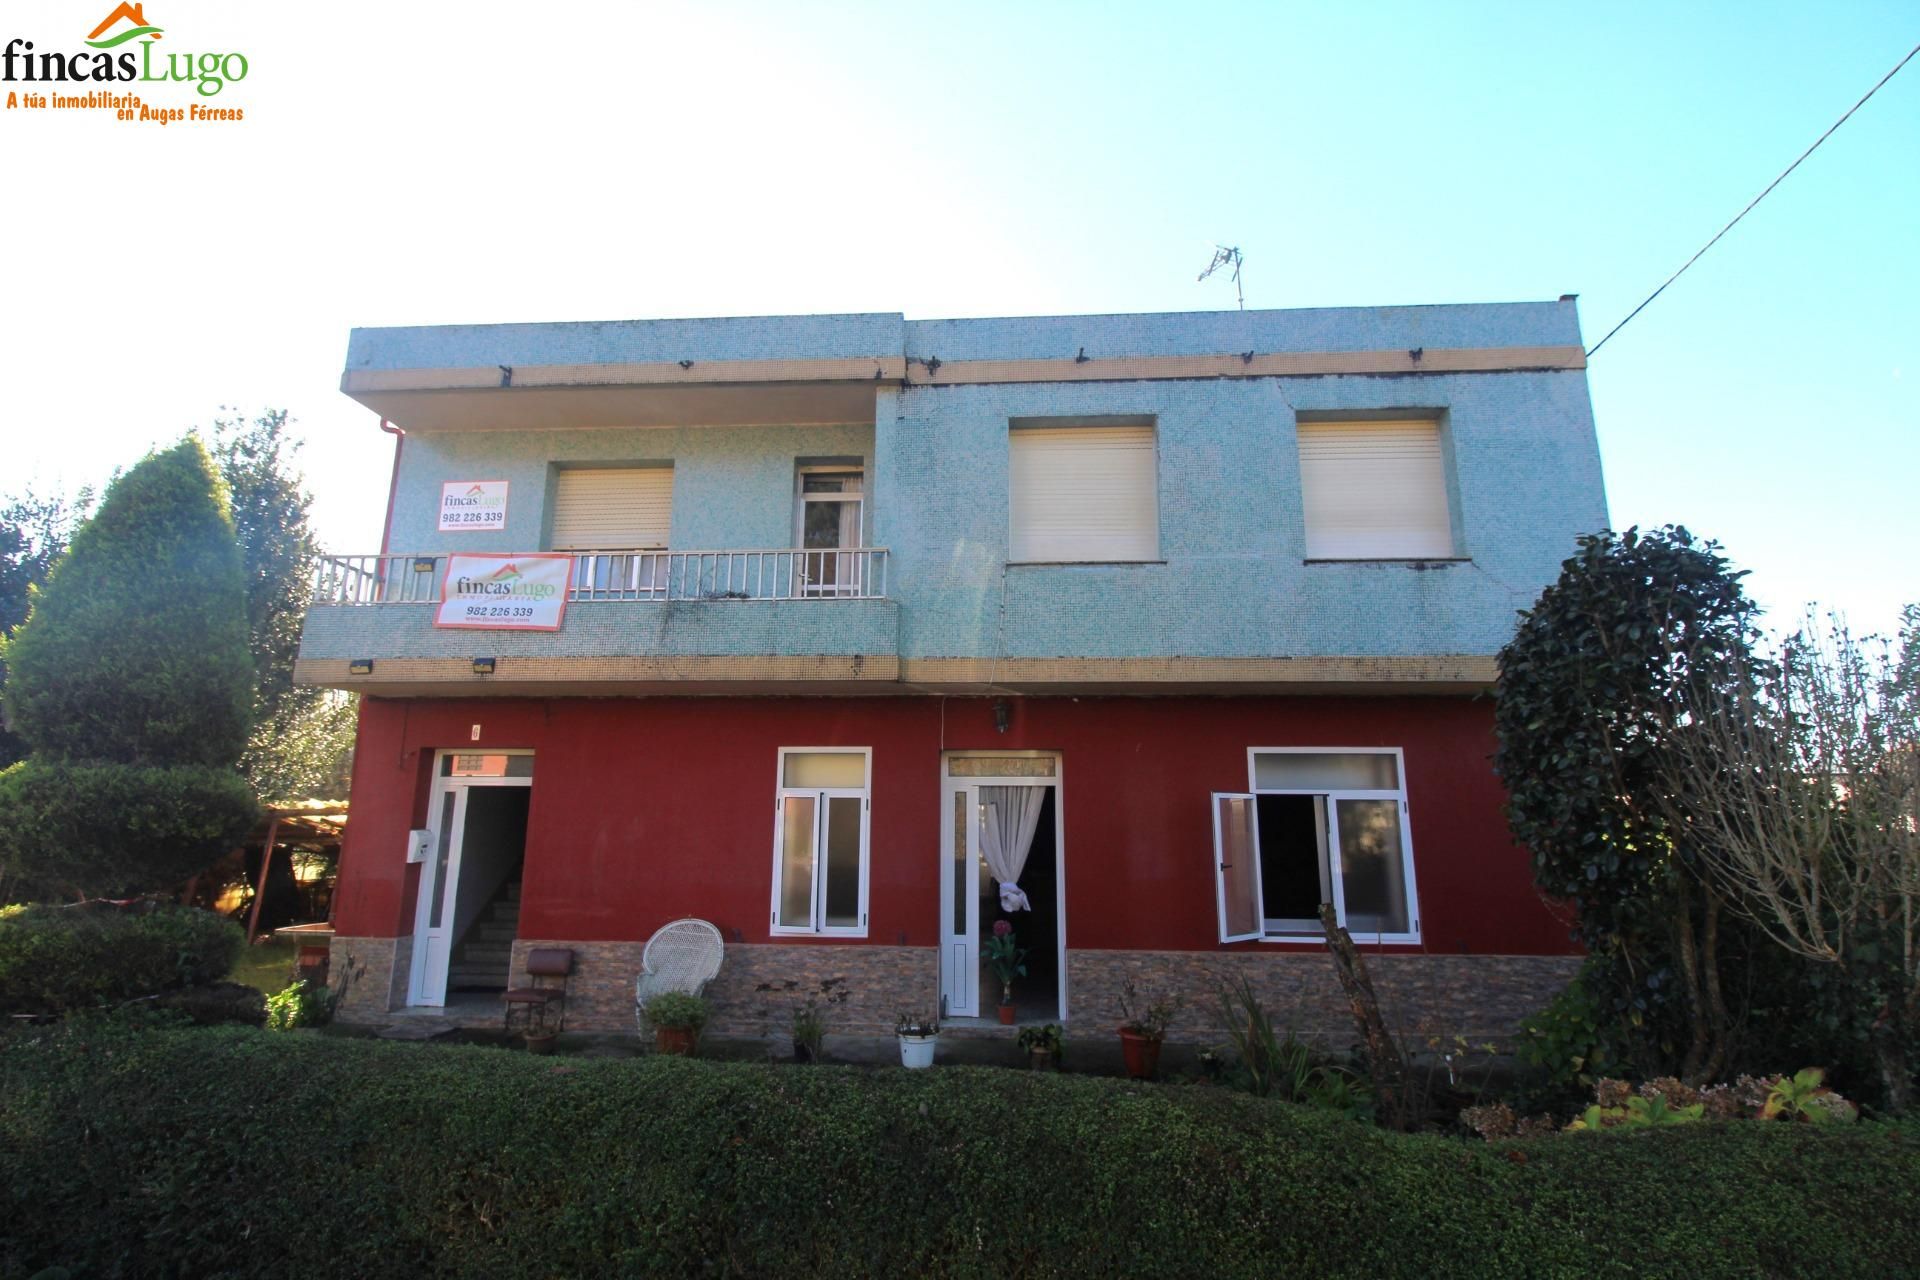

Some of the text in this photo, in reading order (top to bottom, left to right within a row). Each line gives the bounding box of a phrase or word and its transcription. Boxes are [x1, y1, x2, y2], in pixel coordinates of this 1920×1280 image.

[442, 512, 503, 522] 982 226 339
[456, 576, 555, 601] fincasLugo
[466, 606, 533, 617] 982 226 339
